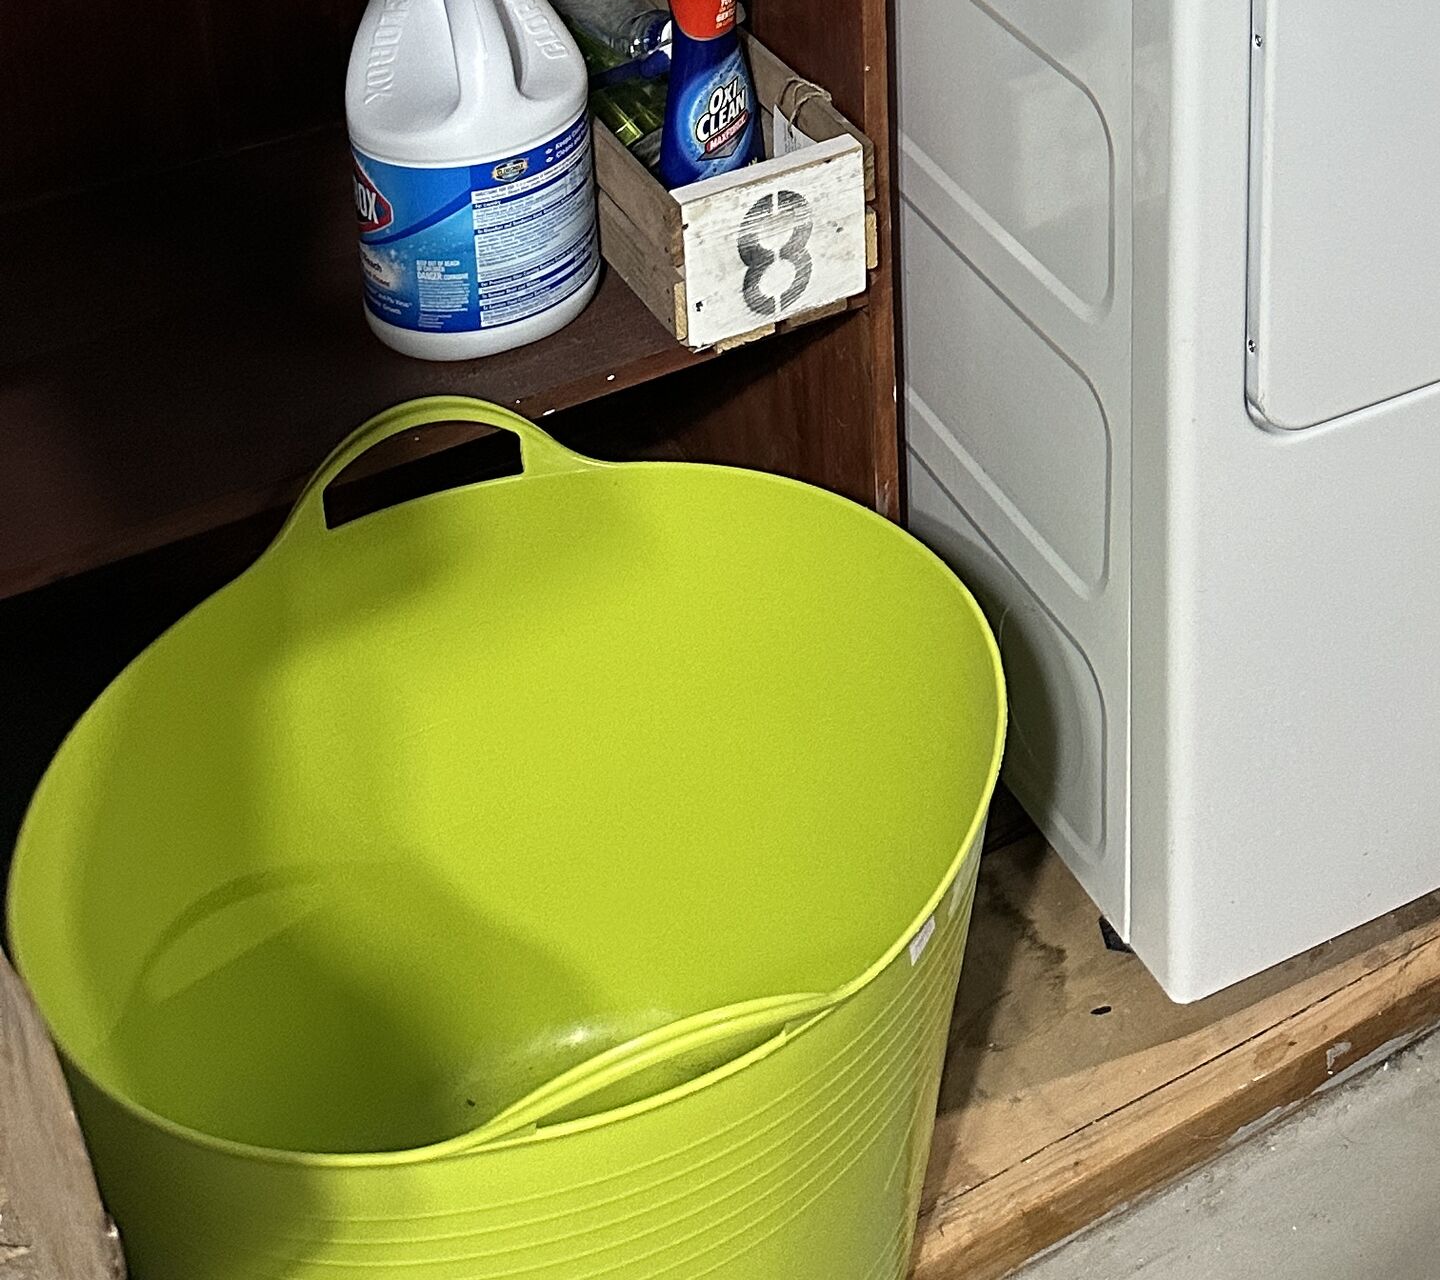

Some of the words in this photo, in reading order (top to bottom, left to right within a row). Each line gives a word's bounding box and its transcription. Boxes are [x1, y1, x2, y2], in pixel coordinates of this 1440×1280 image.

[696, 88, 746, 142] CLEAN
[708, 78, 738, 116] OXI
[736, 190, 813, 316] 8
